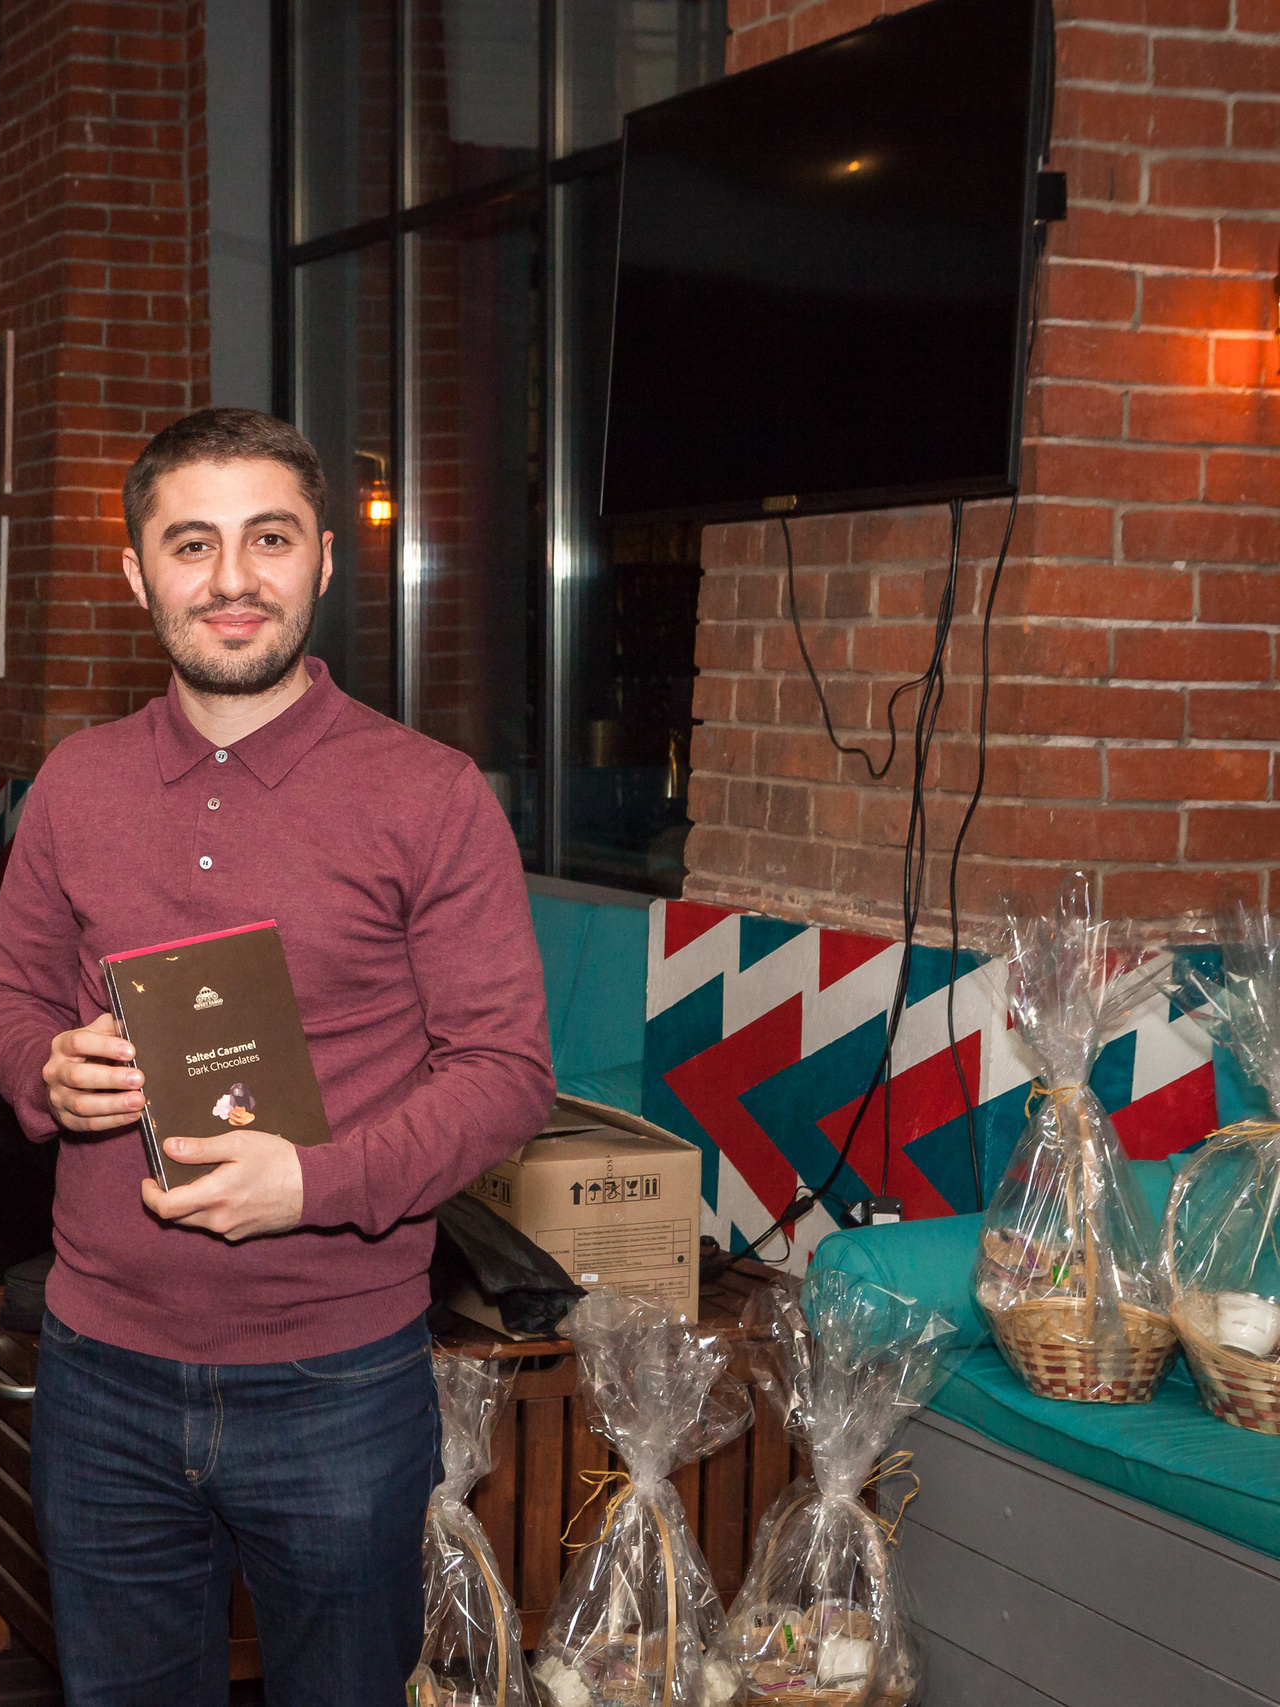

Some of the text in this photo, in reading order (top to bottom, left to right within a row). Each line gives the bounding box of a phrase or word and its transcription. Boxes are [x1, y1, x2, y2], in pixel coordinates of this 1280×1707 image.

[185, 1039, 257, 1064] Salted Caramel
[187, 1053, 260, 1077] Dark Chocolates
